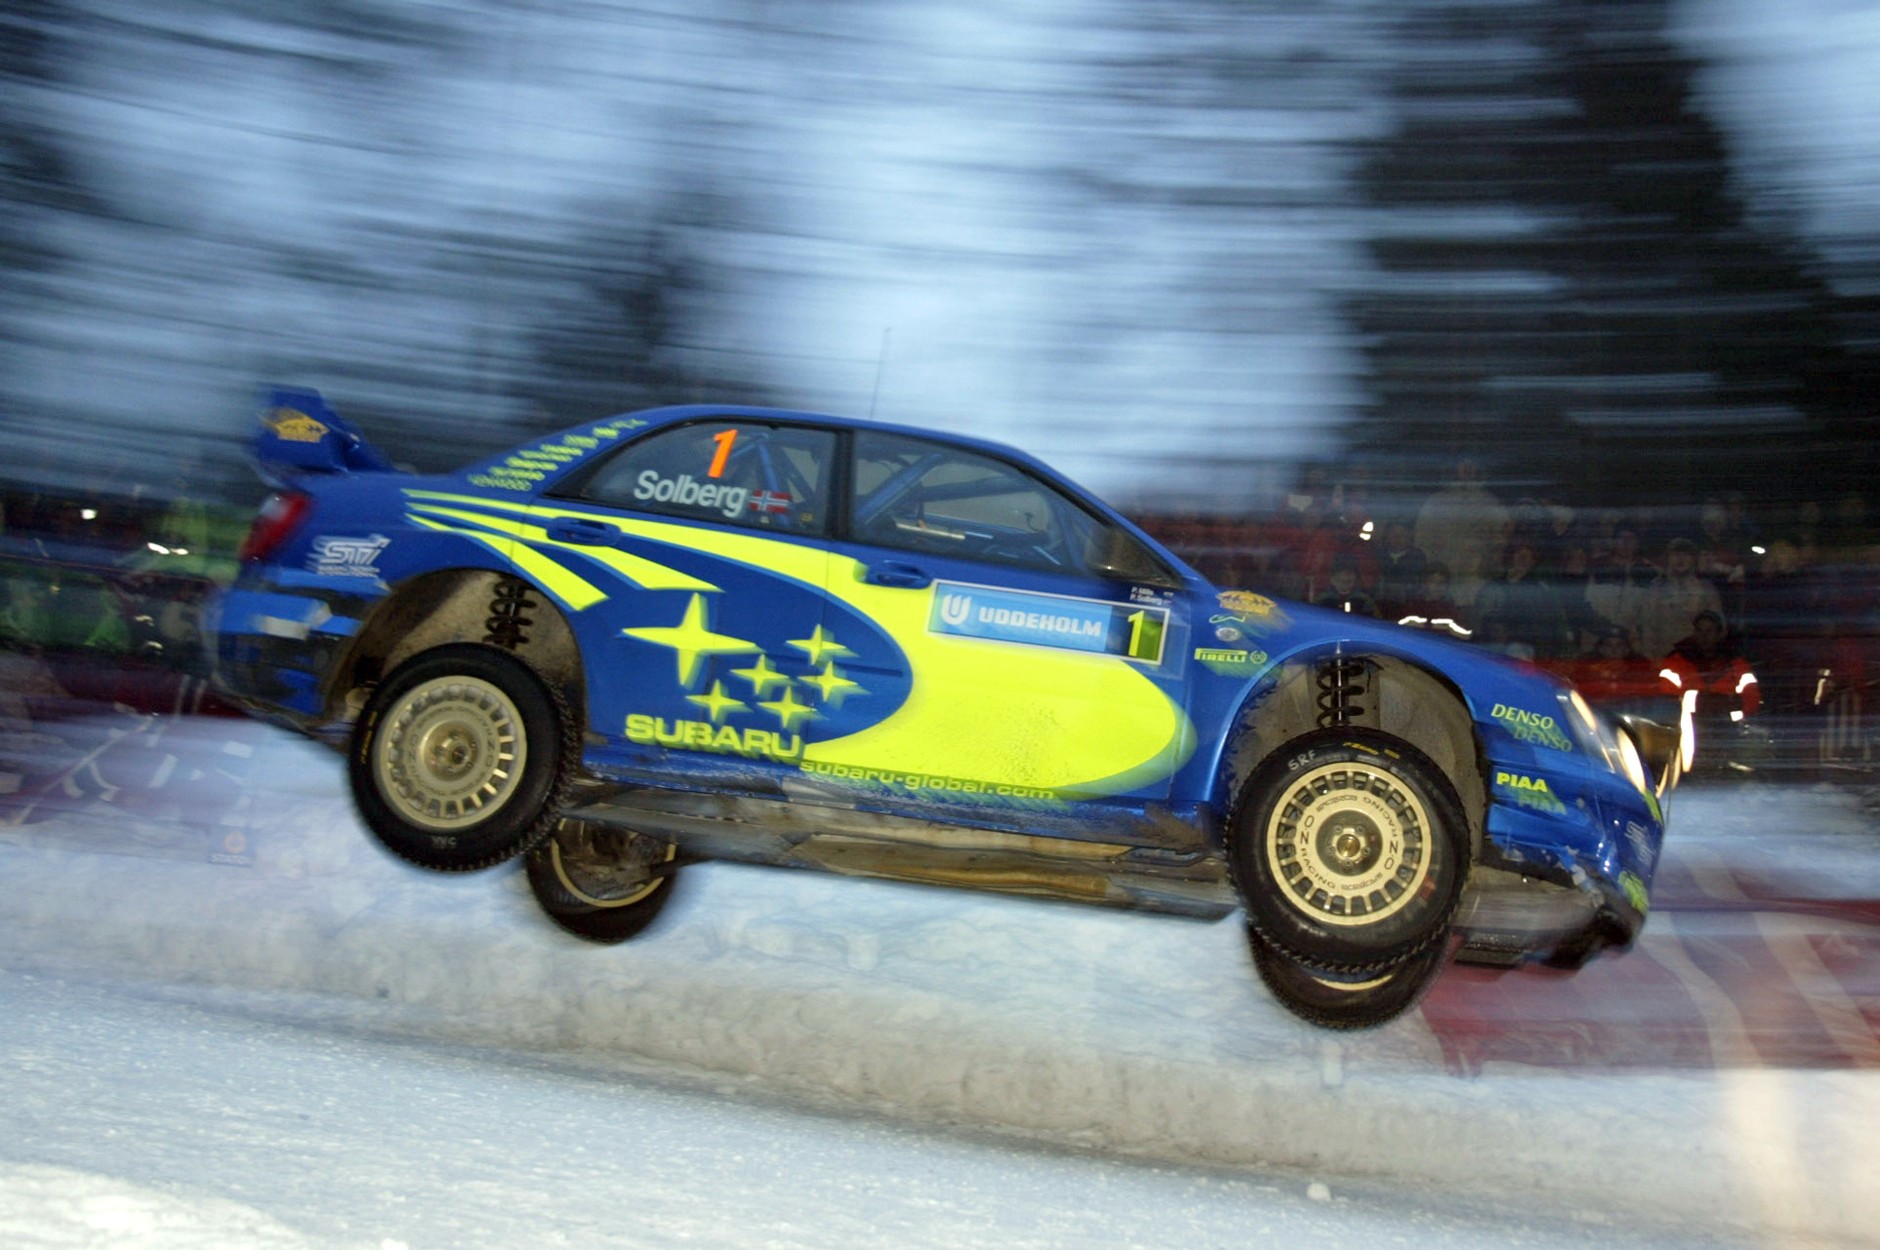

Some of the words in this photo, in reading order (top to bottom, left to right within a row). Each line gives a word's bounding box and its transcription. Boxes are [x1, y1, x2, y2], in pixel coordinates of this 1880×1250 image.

[707, 429, 738, 478] 1
[633, 470, 747, 518] Solberg
[979, 607, 1102, 637] UDDEHOLM
[1128, 610, 1144, 656] 1
[1194, 648, 1248, 662] PIRELLI
[626, 713, 800, 757] SUBARU
[1491, 703, 1554, 730] DENSO
[799, 760, 1055, 799] subaru-global.com
[1496, 772, 1548, 792] PIAA
